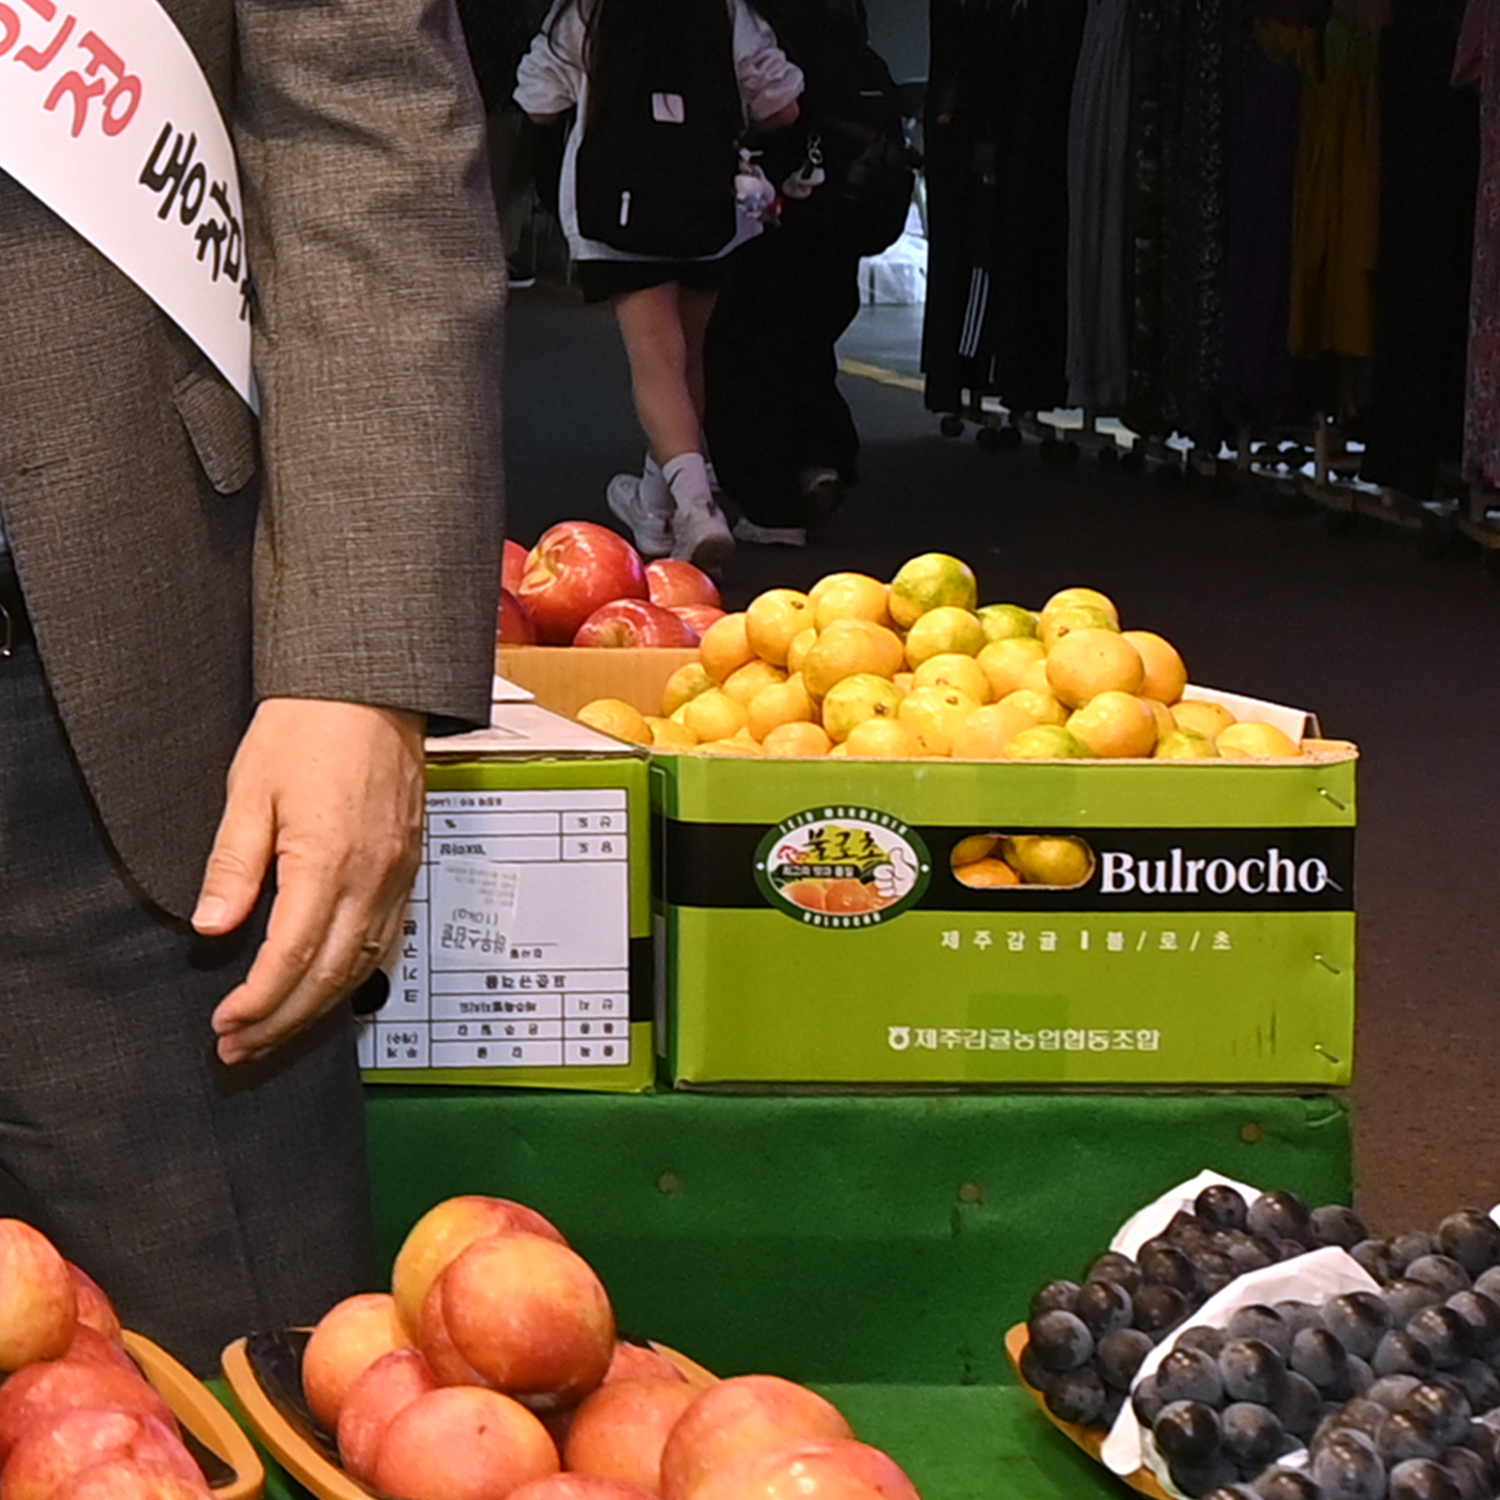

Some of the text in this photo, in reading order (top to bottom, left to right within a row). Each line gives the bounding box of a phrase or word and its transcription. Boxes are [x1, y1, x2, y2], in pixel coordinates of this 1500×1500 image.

[1099, 848, 1328, 894] Bulrocho
[940, 930, 1057, 951] 제주감귤
[915, 1027, 1161, 1052] 제주감귤농업협동조합
